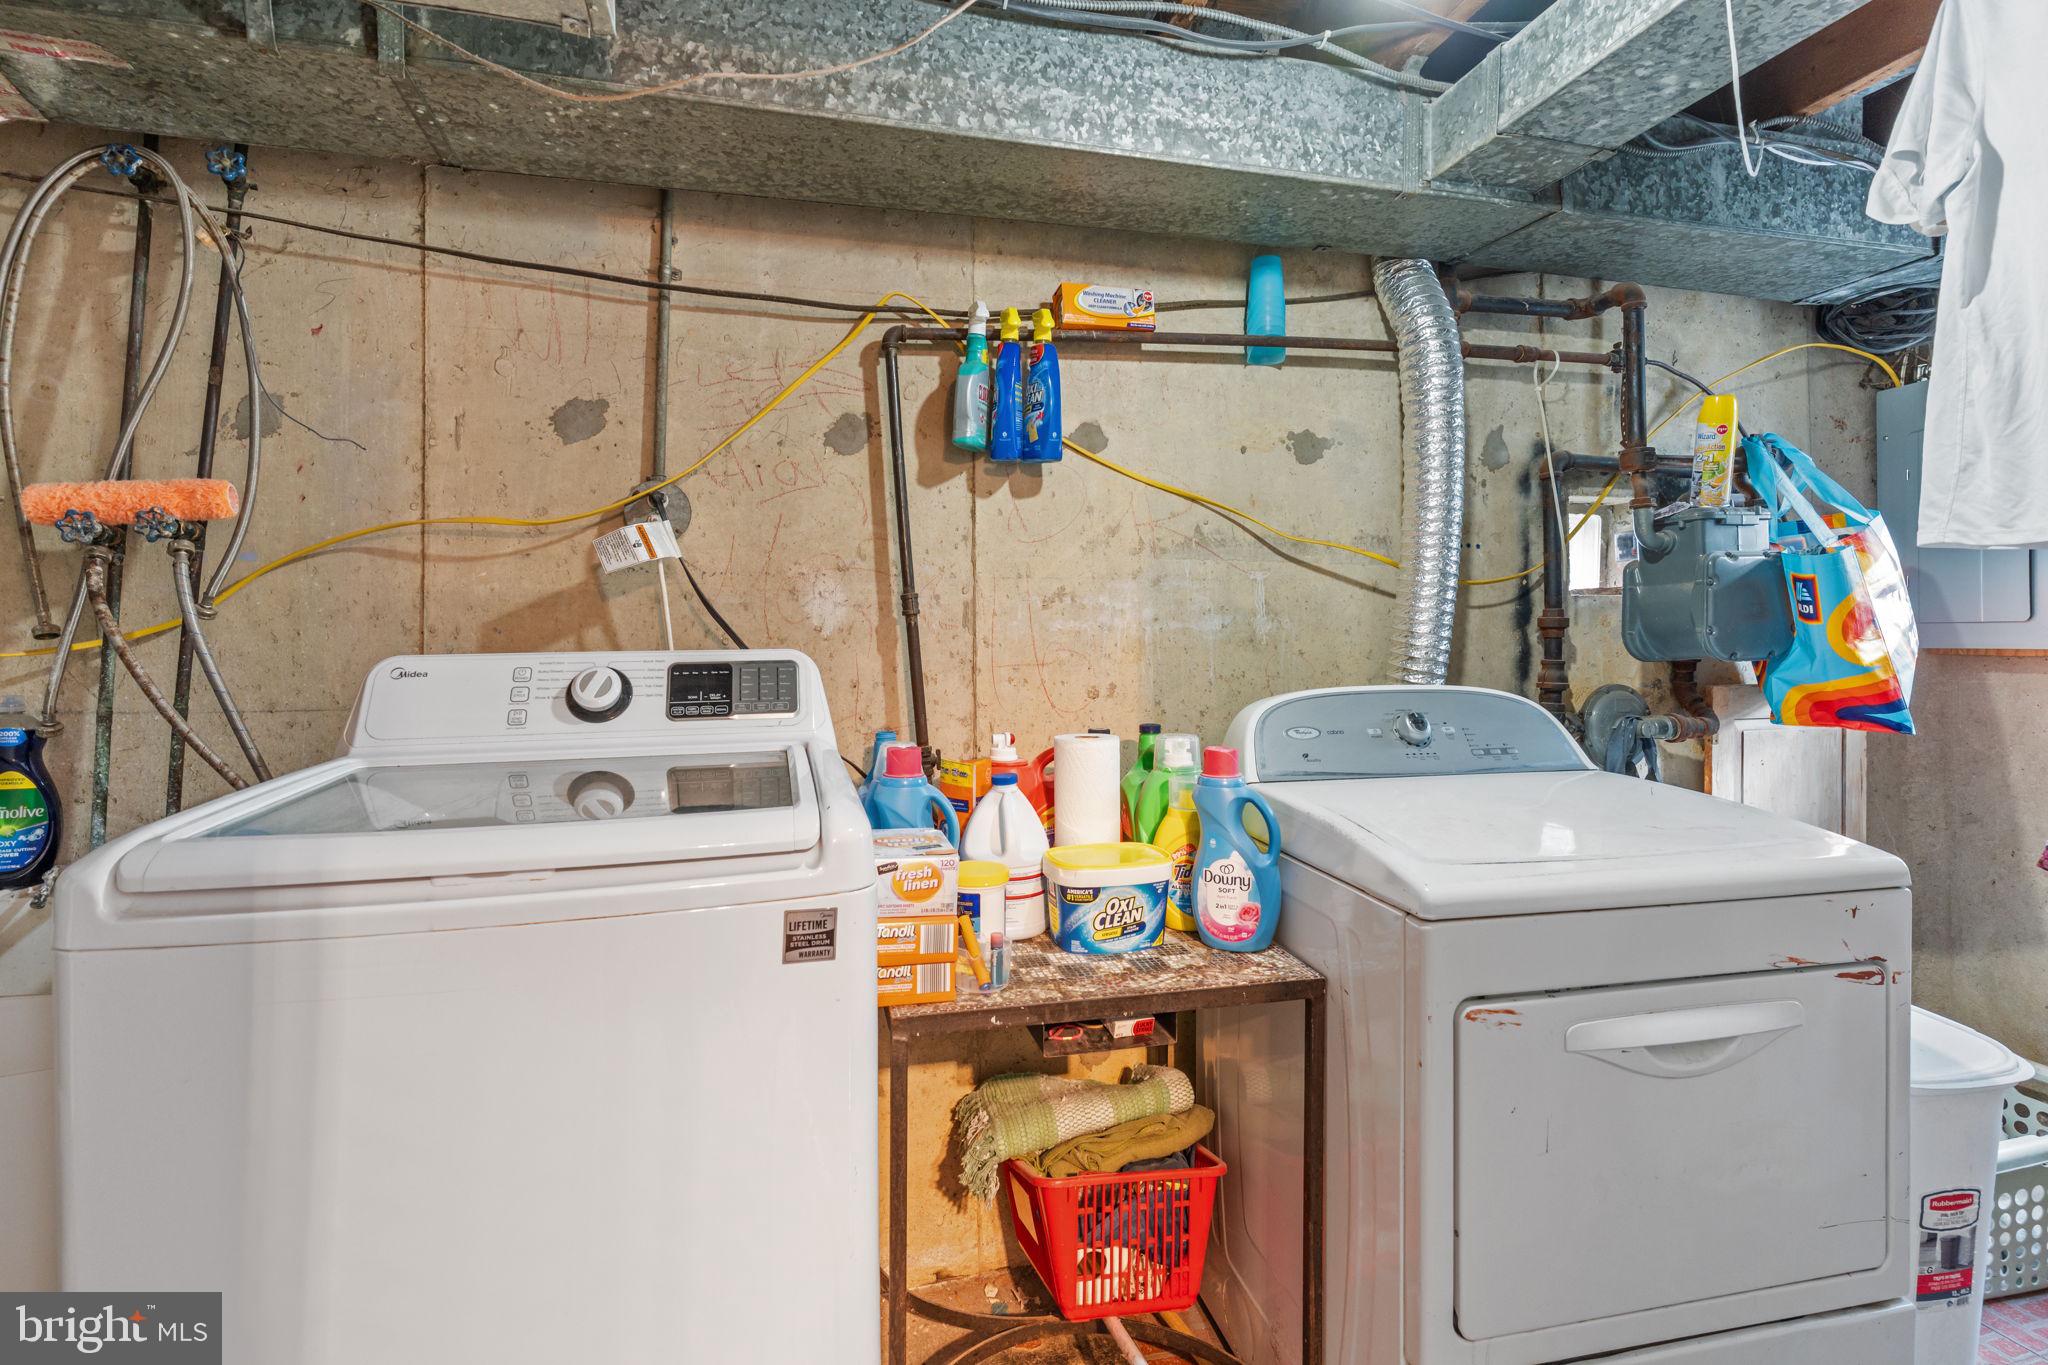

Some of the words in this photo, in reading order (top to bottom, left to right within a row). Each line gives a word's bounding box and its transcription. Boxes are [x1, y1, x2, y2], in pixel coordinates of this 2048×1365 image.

[395, 669, 428, 679] Midea
[895, 865, 933, 881] fresh
[1174, 864, 1192, 881] Tid
[903, 878, 939, 892] linen
[1204, 869, 1251, 892] Downy
[1106, 896, 1135, 915] OXI
[788, 920, 828, 932] LIFETIME
[1093, 907, 1143, 931] CLEAN
[792, 934, 827, 942] STAINLESS
[877, 924, 916, 938] Tandil
[798, 950, 831, 959] WARRANTY
[1931, 1198, 1973, 1208] Rubbermaid
